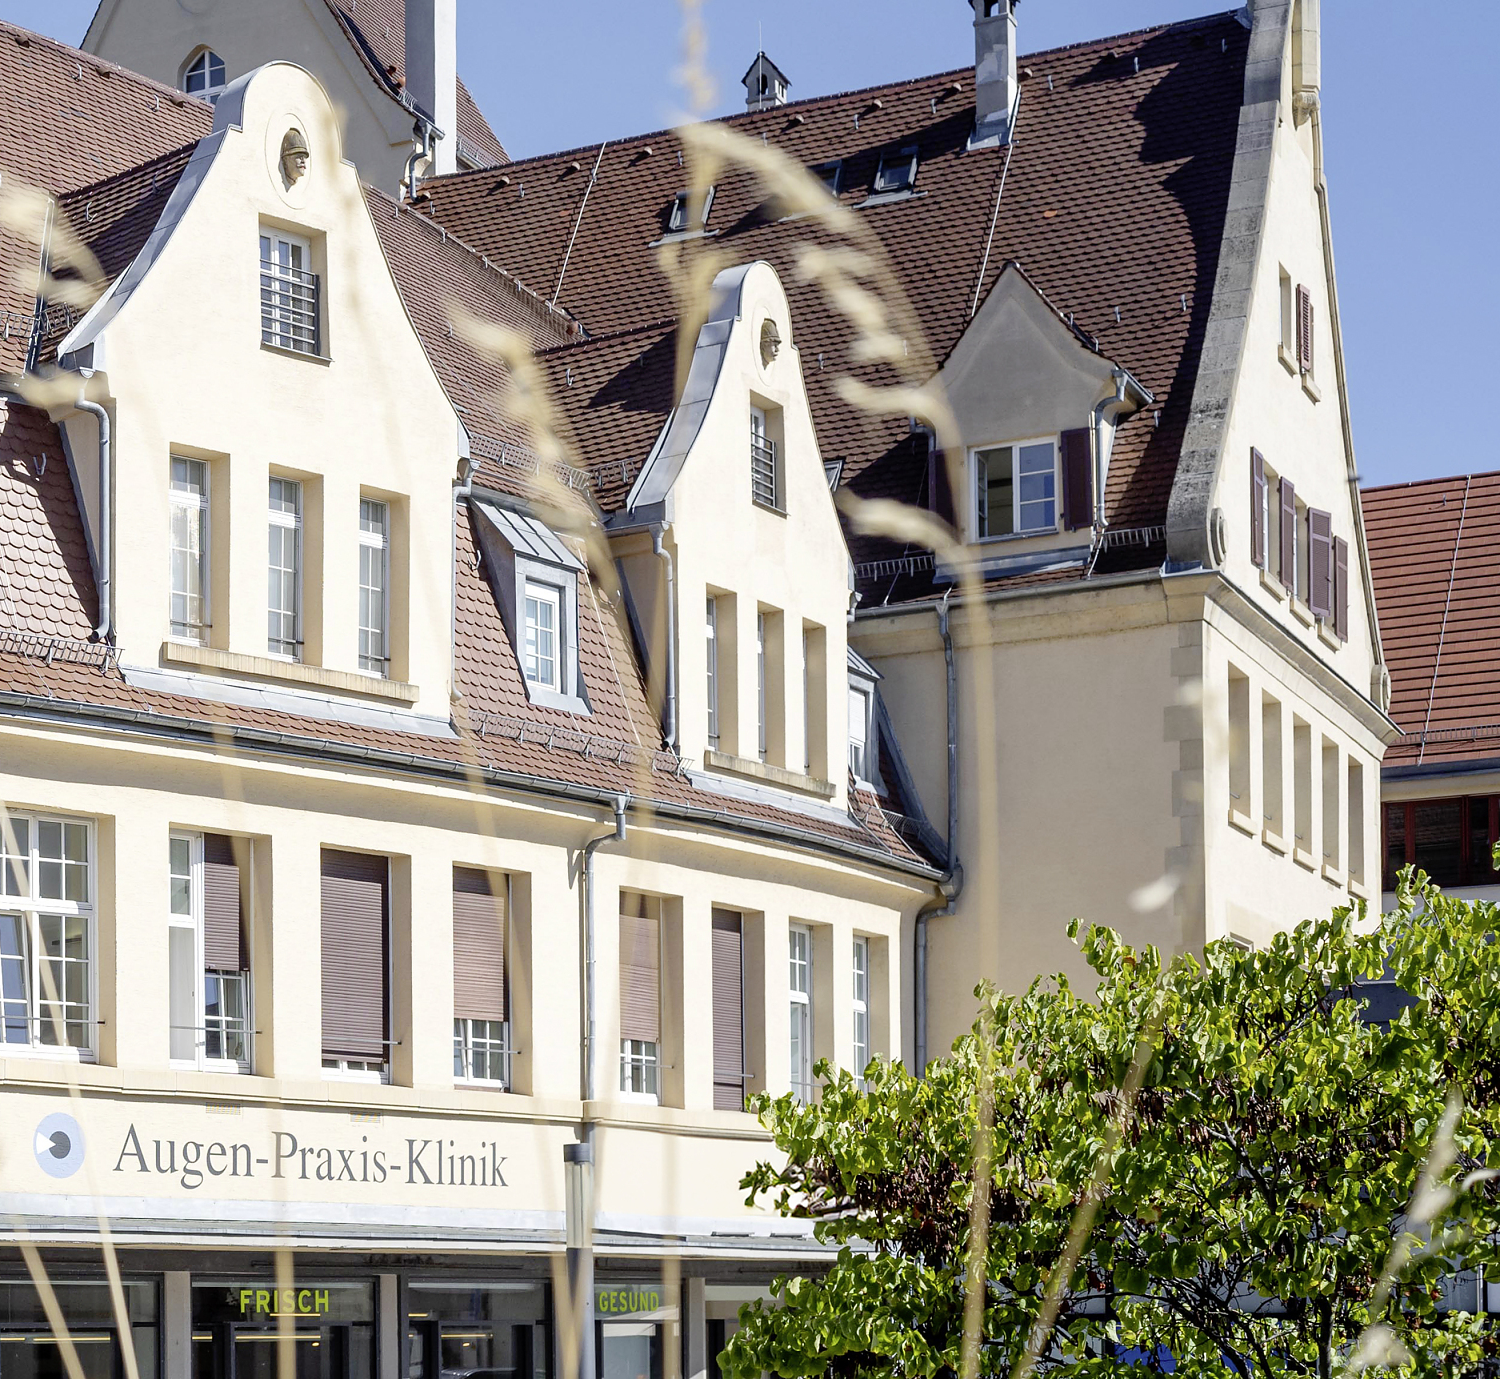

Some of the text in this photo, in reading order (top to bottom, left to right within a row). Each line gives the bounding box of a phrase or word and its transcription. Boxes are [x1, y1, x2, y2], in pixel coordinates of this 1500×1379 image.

[113, 1122, 509, 1189] Augen-Praxis-Klinik
[239, 1289, 330, 1314] FRISCH
[599, 1290, 660, 1312] GESUND
